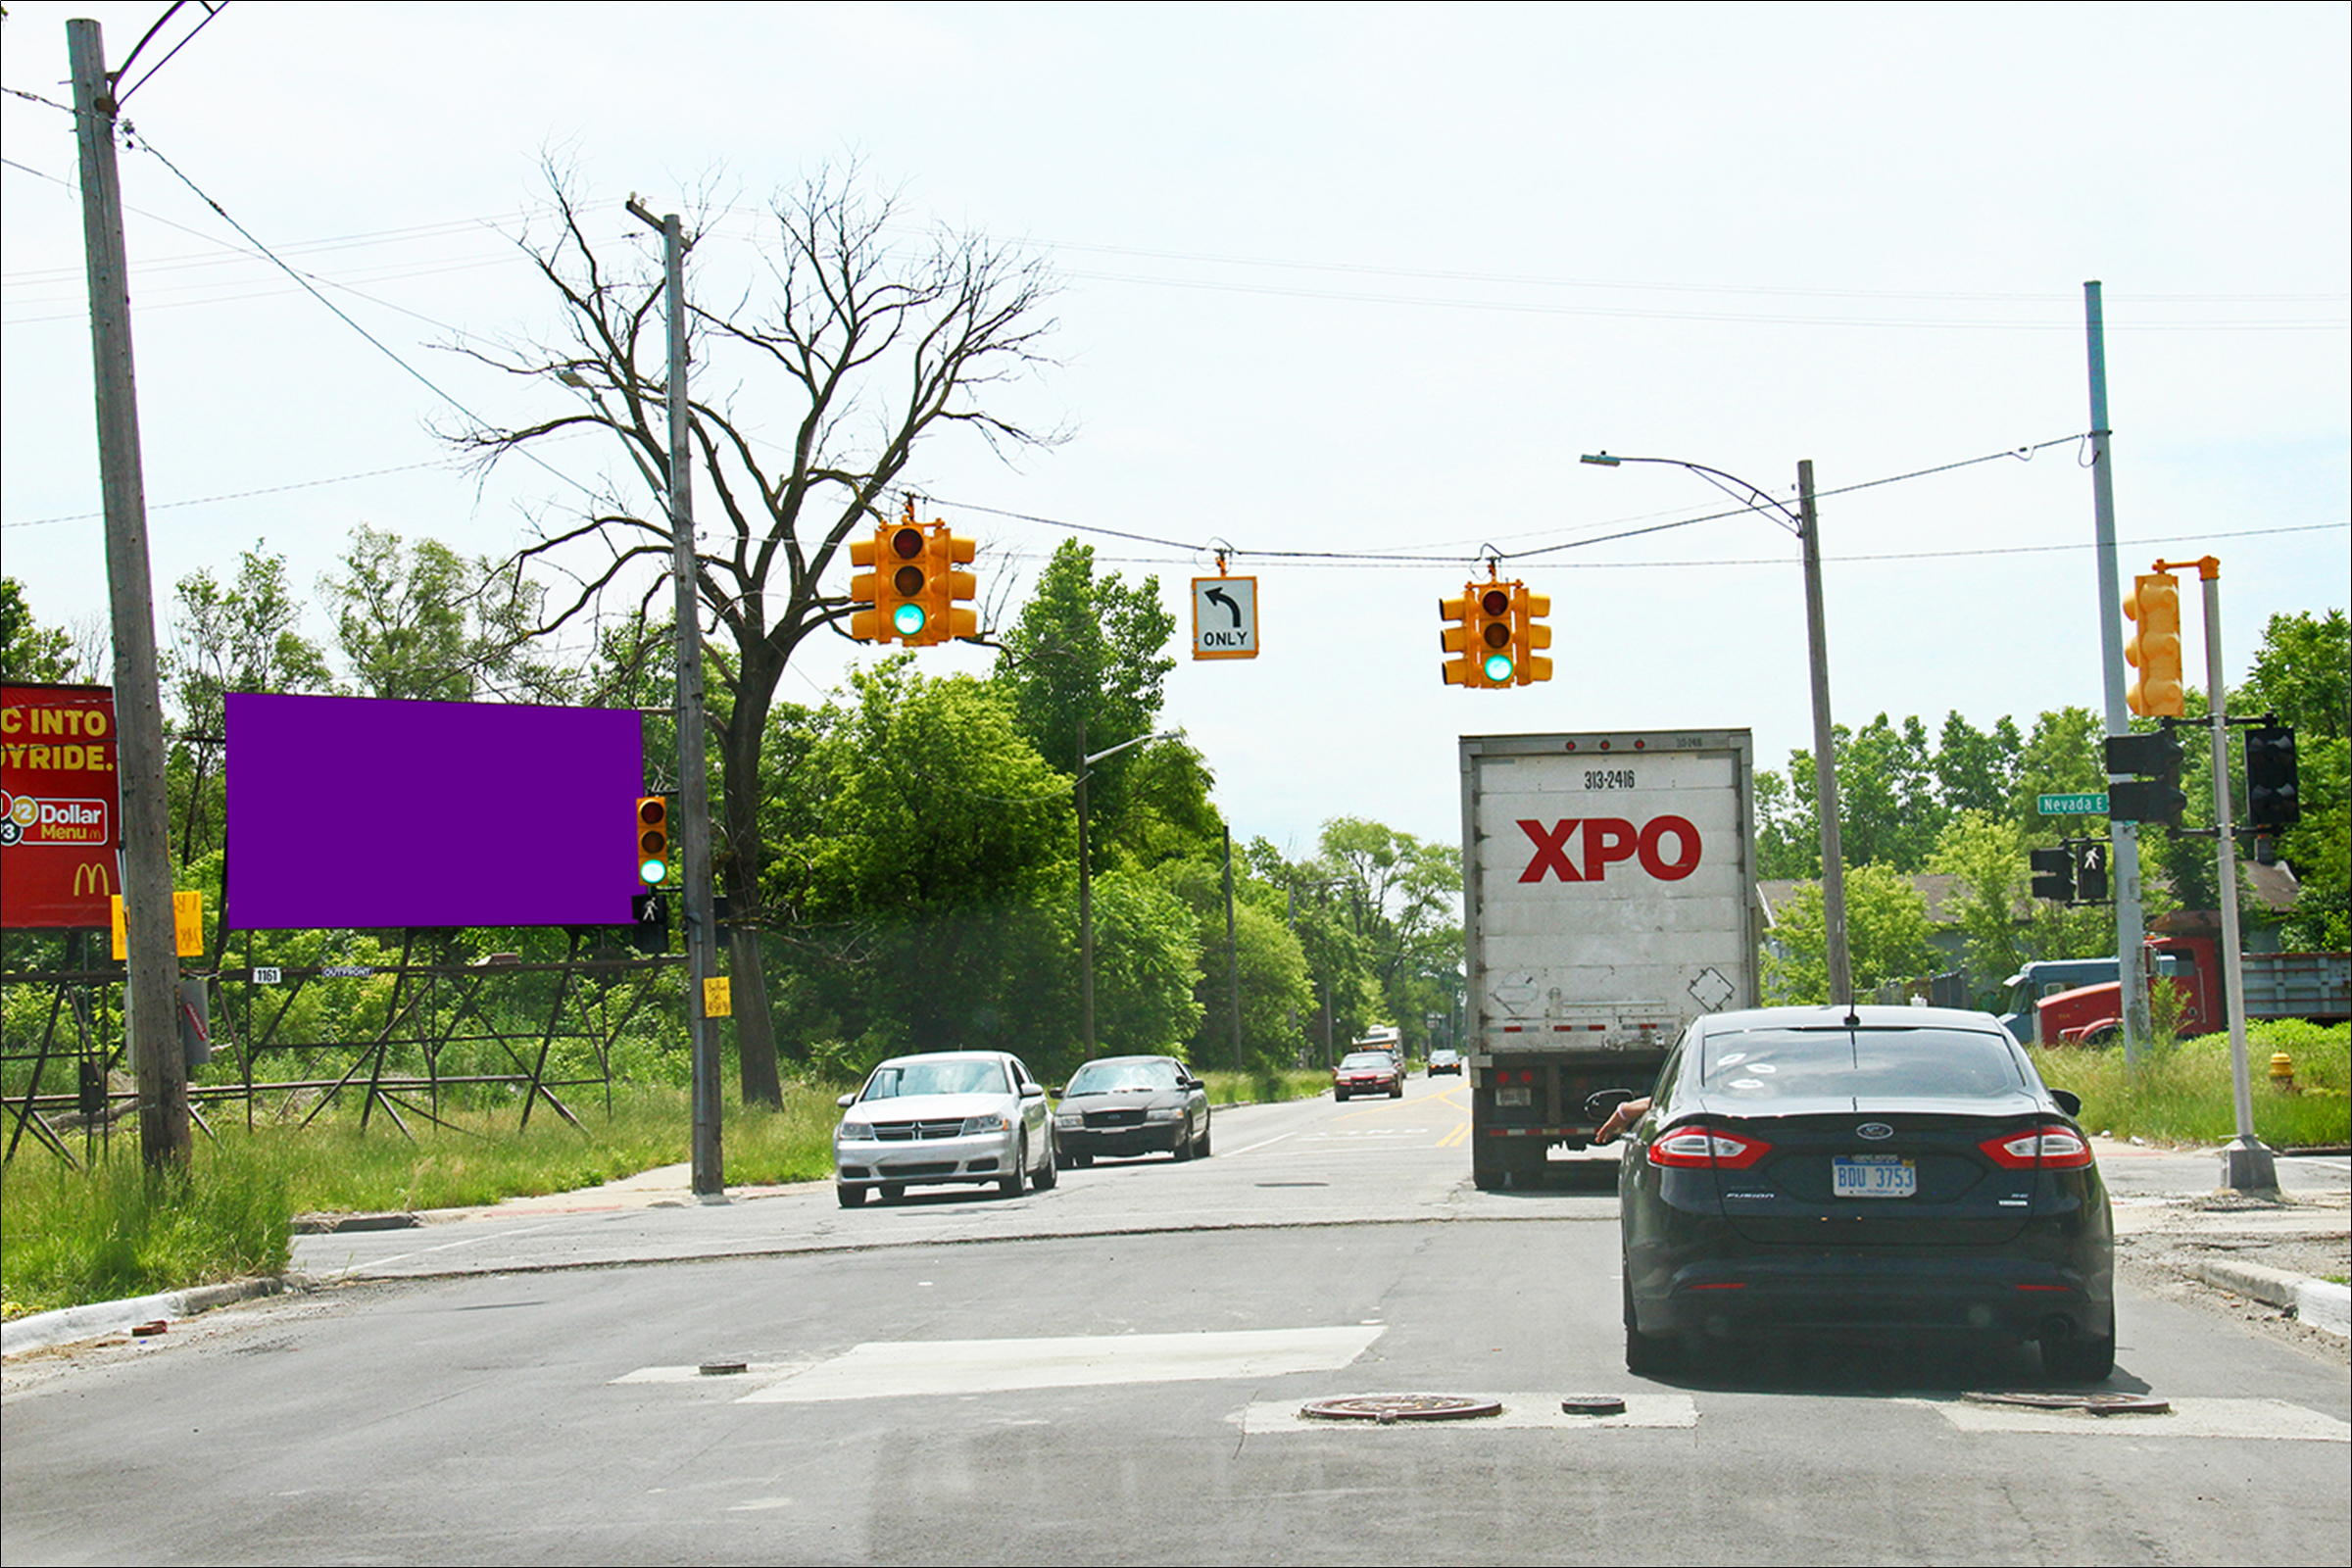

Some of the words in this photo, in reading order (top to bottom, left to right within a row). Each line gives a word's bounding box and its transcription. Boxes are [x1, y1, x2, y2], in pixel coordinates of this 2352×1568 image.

[1203, 632, 1248, 646] ONLY
[30, 709, 107, 737] INTO
[1585, 770, 1635, 789] 313-2416
[2044, 797, 2091, 811] Nevada
[2096, 797, 2102, 810] E
[41, 805, 102, 824] Dollar
[41, 824, 87, 840] Menu
[1516, 815, 1702, 883] XPO
[258, 968, 278, 982] 1161
[1838, 1167, 1866, 1188] BDU
[1876, 1167, 1913, 1188] 3753
